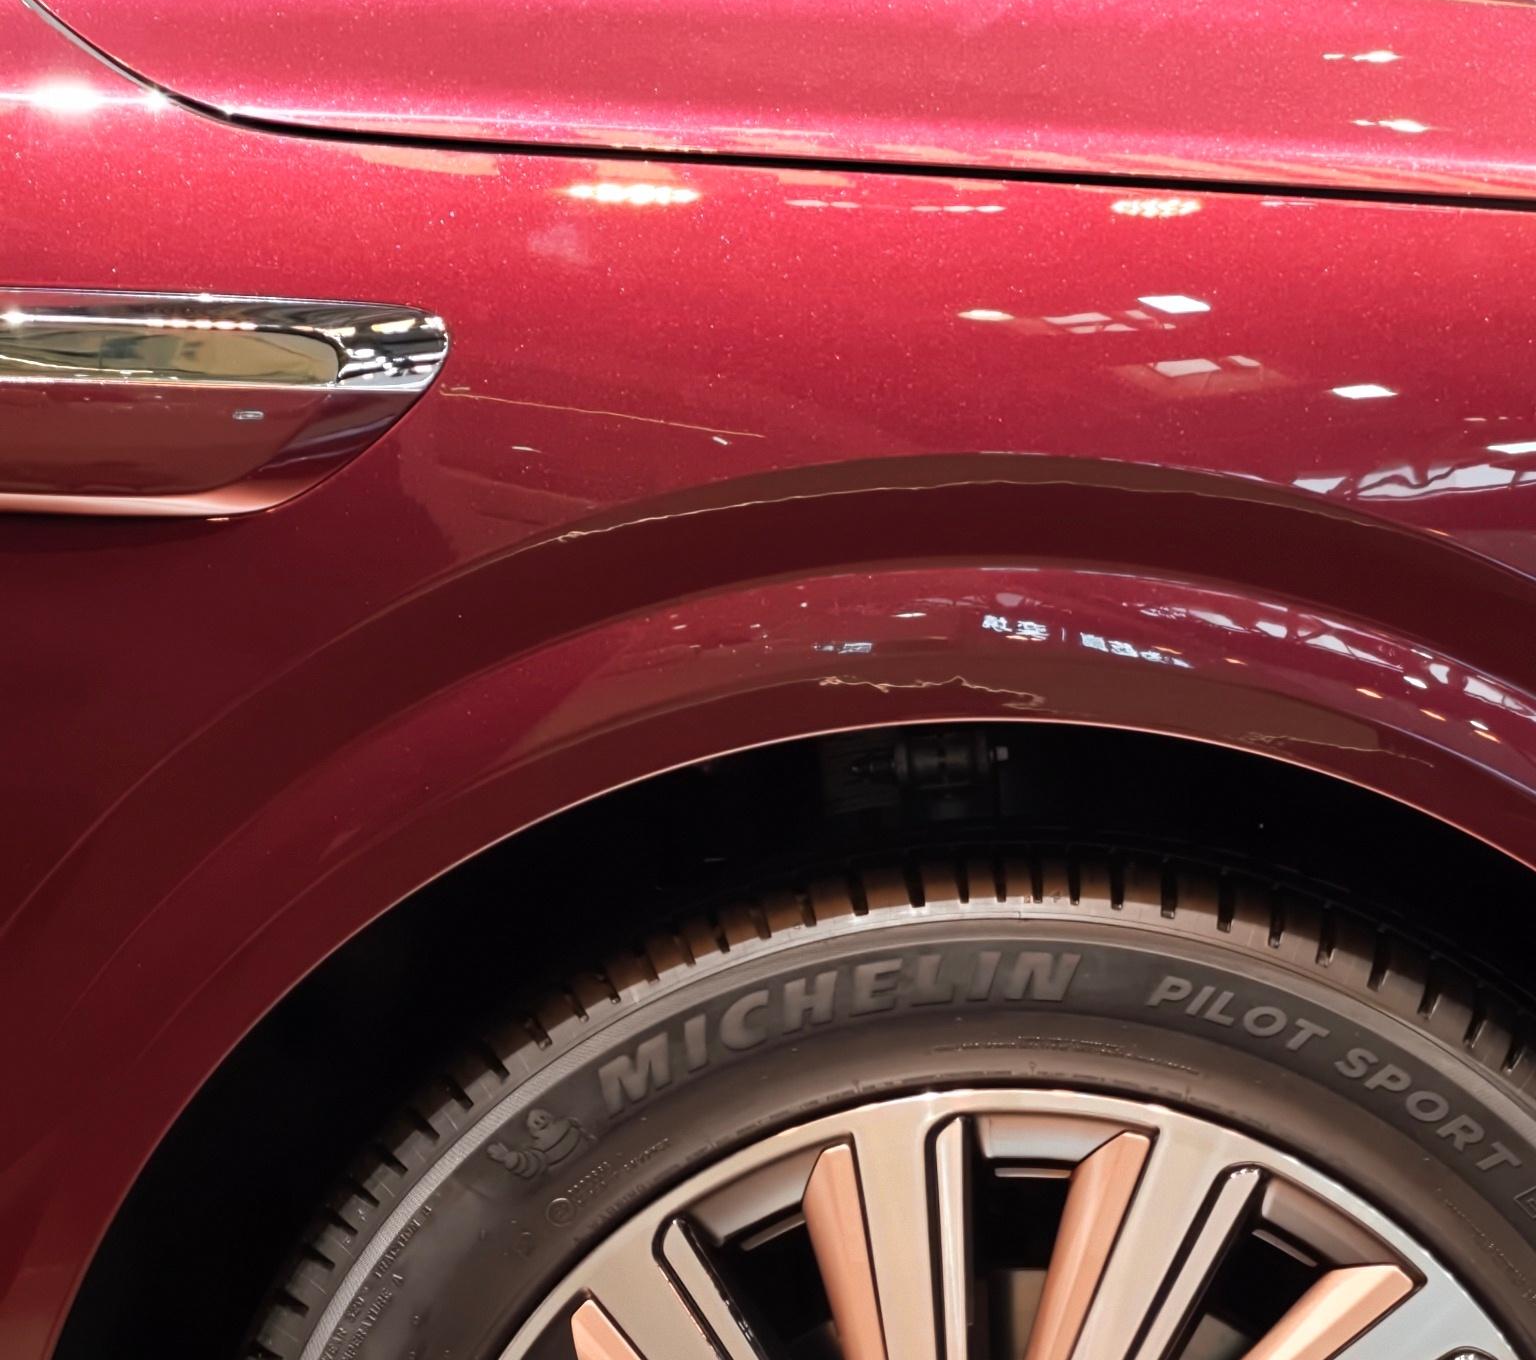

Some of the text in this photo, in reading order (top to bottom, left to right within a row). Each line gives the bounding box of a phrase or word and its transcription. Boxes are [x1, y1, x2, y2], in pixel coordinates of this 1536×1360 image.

[599, 952, 1082, 1120] MICHELIN
[1146, 975, 1329, 1051] PILOT
[1334, 1046, 1521, 1173] SPORT
